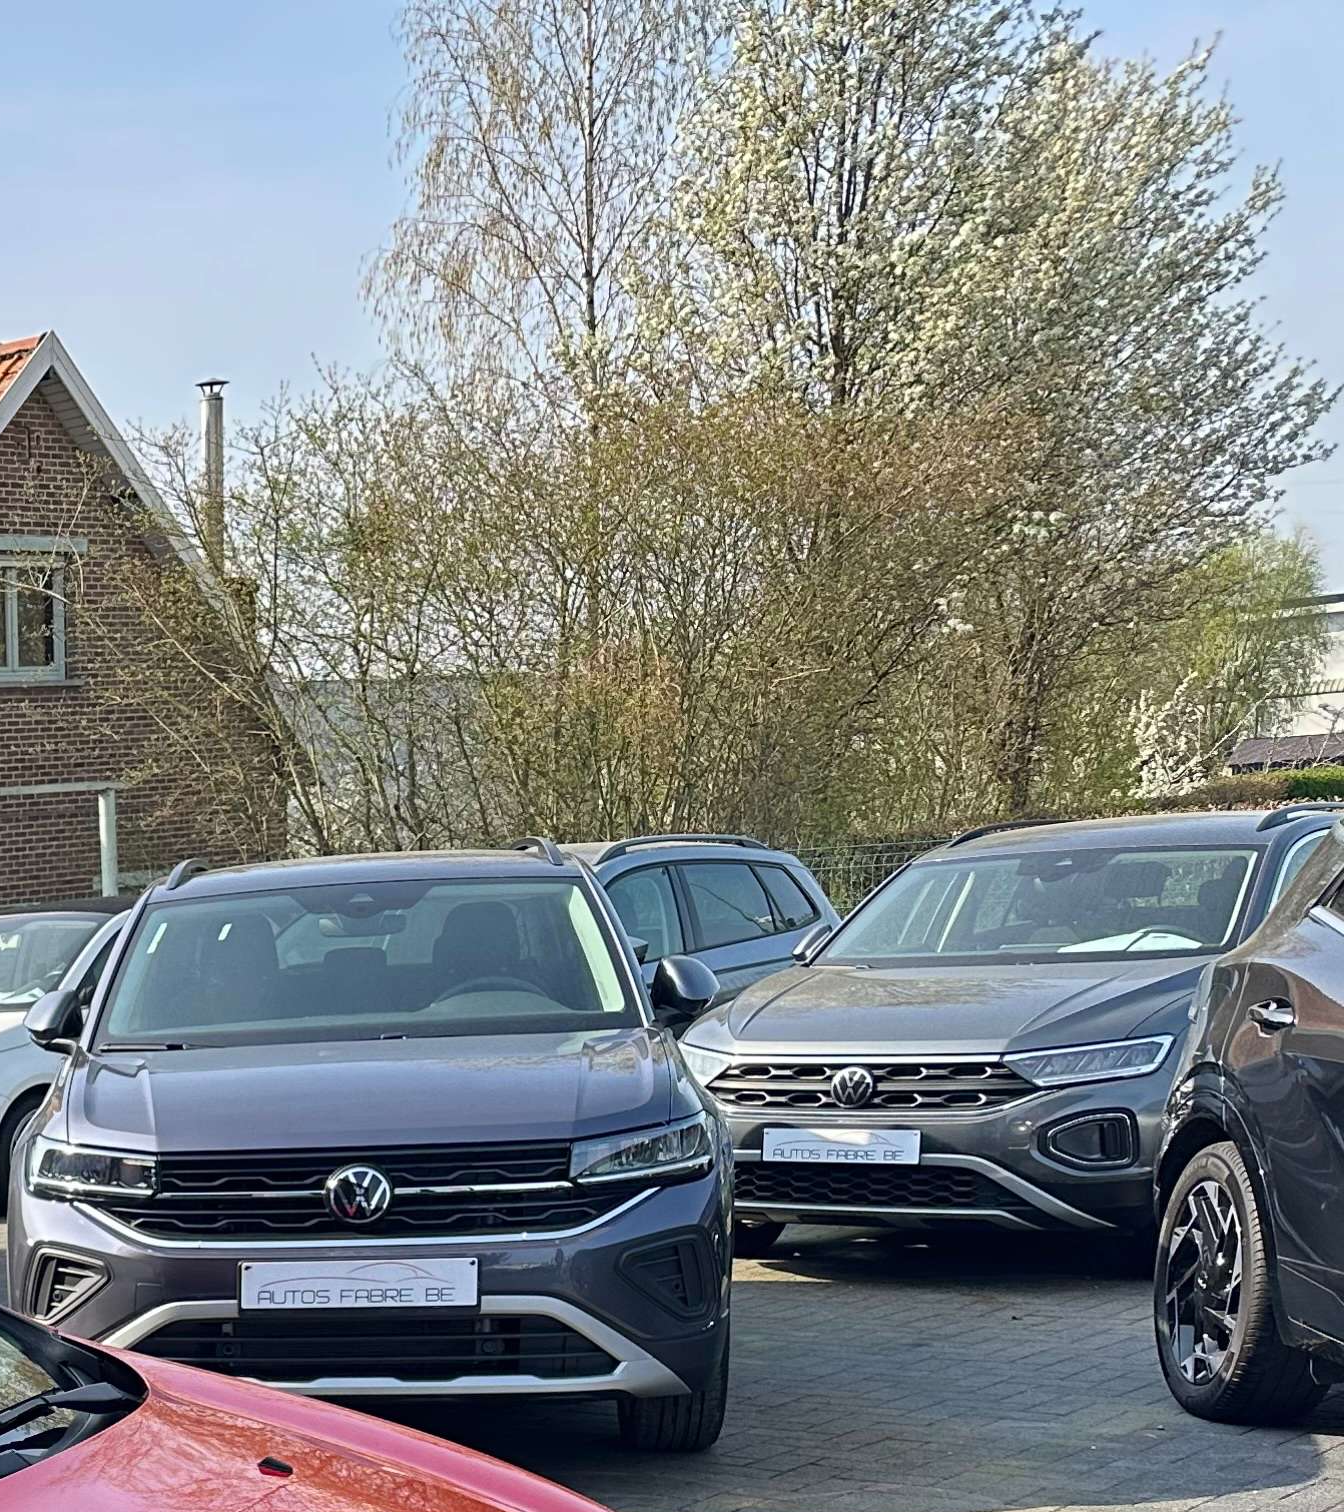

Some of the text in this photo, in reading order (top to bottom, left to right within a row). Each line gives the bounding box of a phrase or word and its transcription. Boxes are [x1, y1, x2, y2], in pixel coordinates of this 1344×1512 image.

[772, 1148, 821, 1160] AUTOS
[257, 1286, 456, 1305] AUTOS FABRE BE
